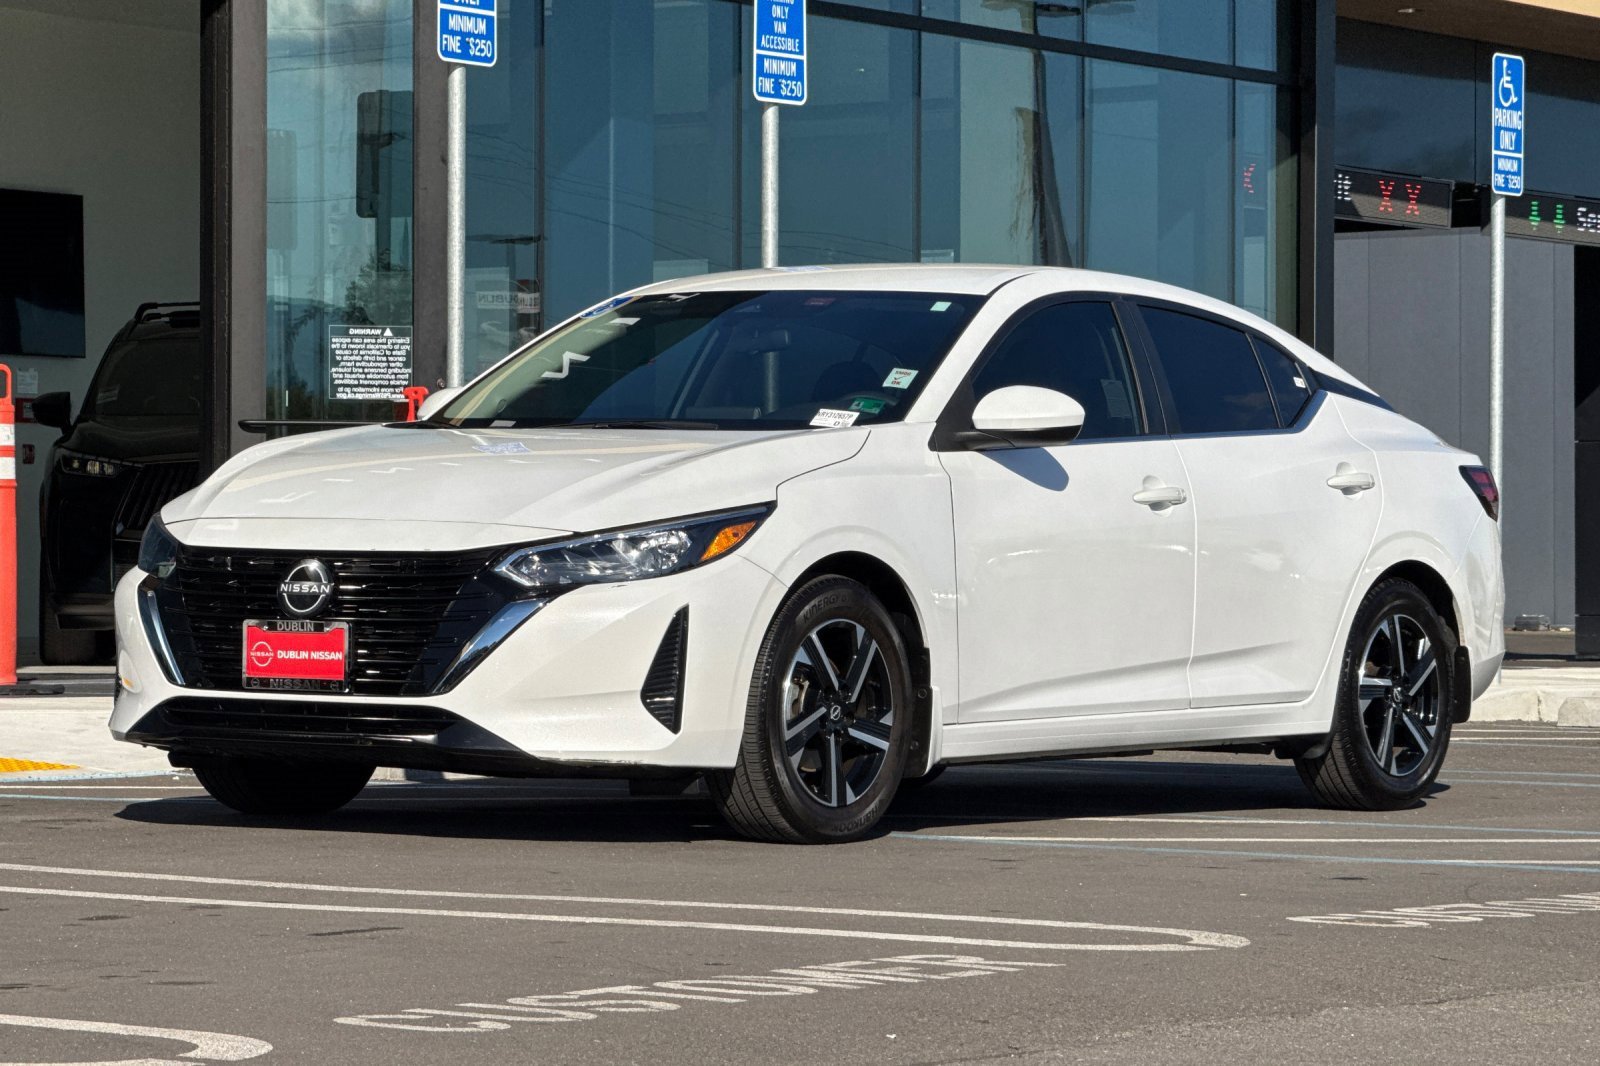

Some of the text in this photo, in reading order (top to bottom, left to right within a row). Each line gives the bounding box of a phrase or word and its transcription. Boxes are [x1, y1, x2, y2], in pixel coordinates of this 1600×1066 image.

[772, 4, 789, 19] ONLY
[449, 13, 486, 36] MINIMUM
[774, 20, 787, 34] VAN
[442, 34, 492, 58] FINE $250
[761, 34, 800, 52] ACCESSIBLE
[764, 58, 796, 77] MINIMUM
[758, 76, 802, 97] FINE $250
[1495, 108, 1522, 130] PARKING
[1500, 130, 1516, 150] ONLY
[1495, 174, 1505, 188] FINE
[281, 584, 330, 593] NISSAN
[277, 622, 314, 632] DUBLIN
[278, 650, 342, 660] DUBLIN NISSAN
[269, 678, 320, 688] NISSAN
[334, 954, 1066, 1032] CUSTOMER
